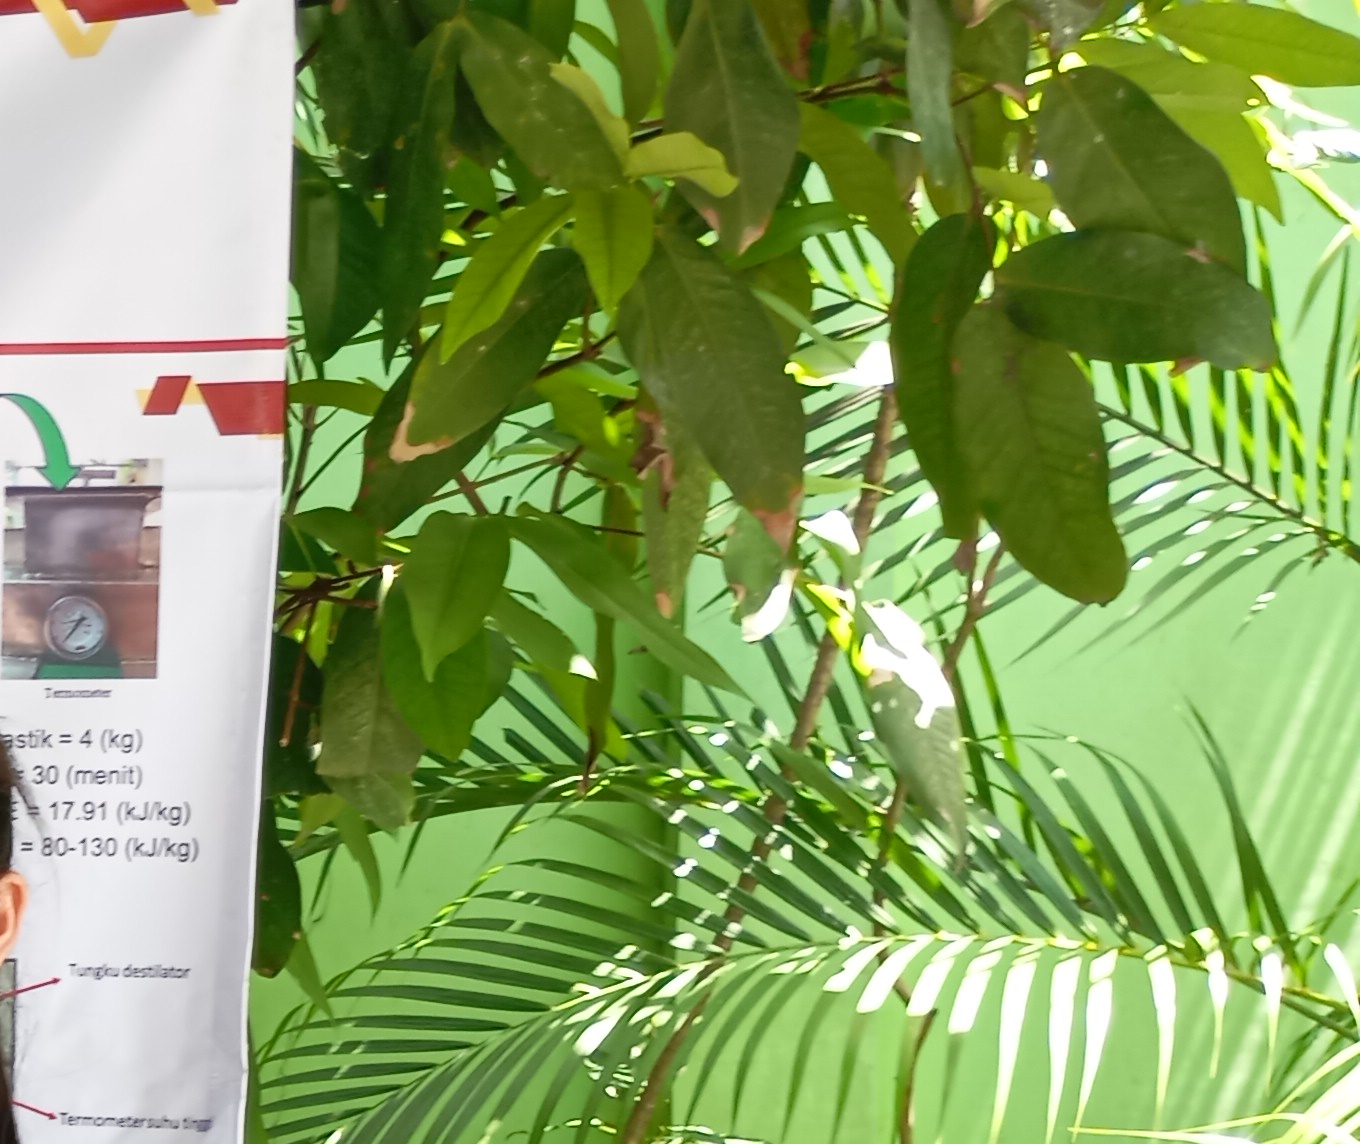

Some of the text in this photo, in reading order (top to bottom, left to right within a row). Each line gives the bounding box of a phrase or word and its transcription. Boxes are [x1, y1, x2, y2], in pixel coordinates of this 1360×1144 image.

[2, 730, 53, 749] astik
[79, 729, 93, 749] 4
[100, 729, 144, 753] (kg)
[32, 765, 59, 784] 30
[66, 765, 143, 790] (menit)
[49, 801, 108, 821] 17.91
[116, 801, 192, 826] (kJ/kg)
[41, 837, 118, 857] 80-130
[125, 837, 199, 863] (kJ/kg)
[69, 963, 191, 981] Tungku destilator
[60, 1112, 147, 1129] Termometer
